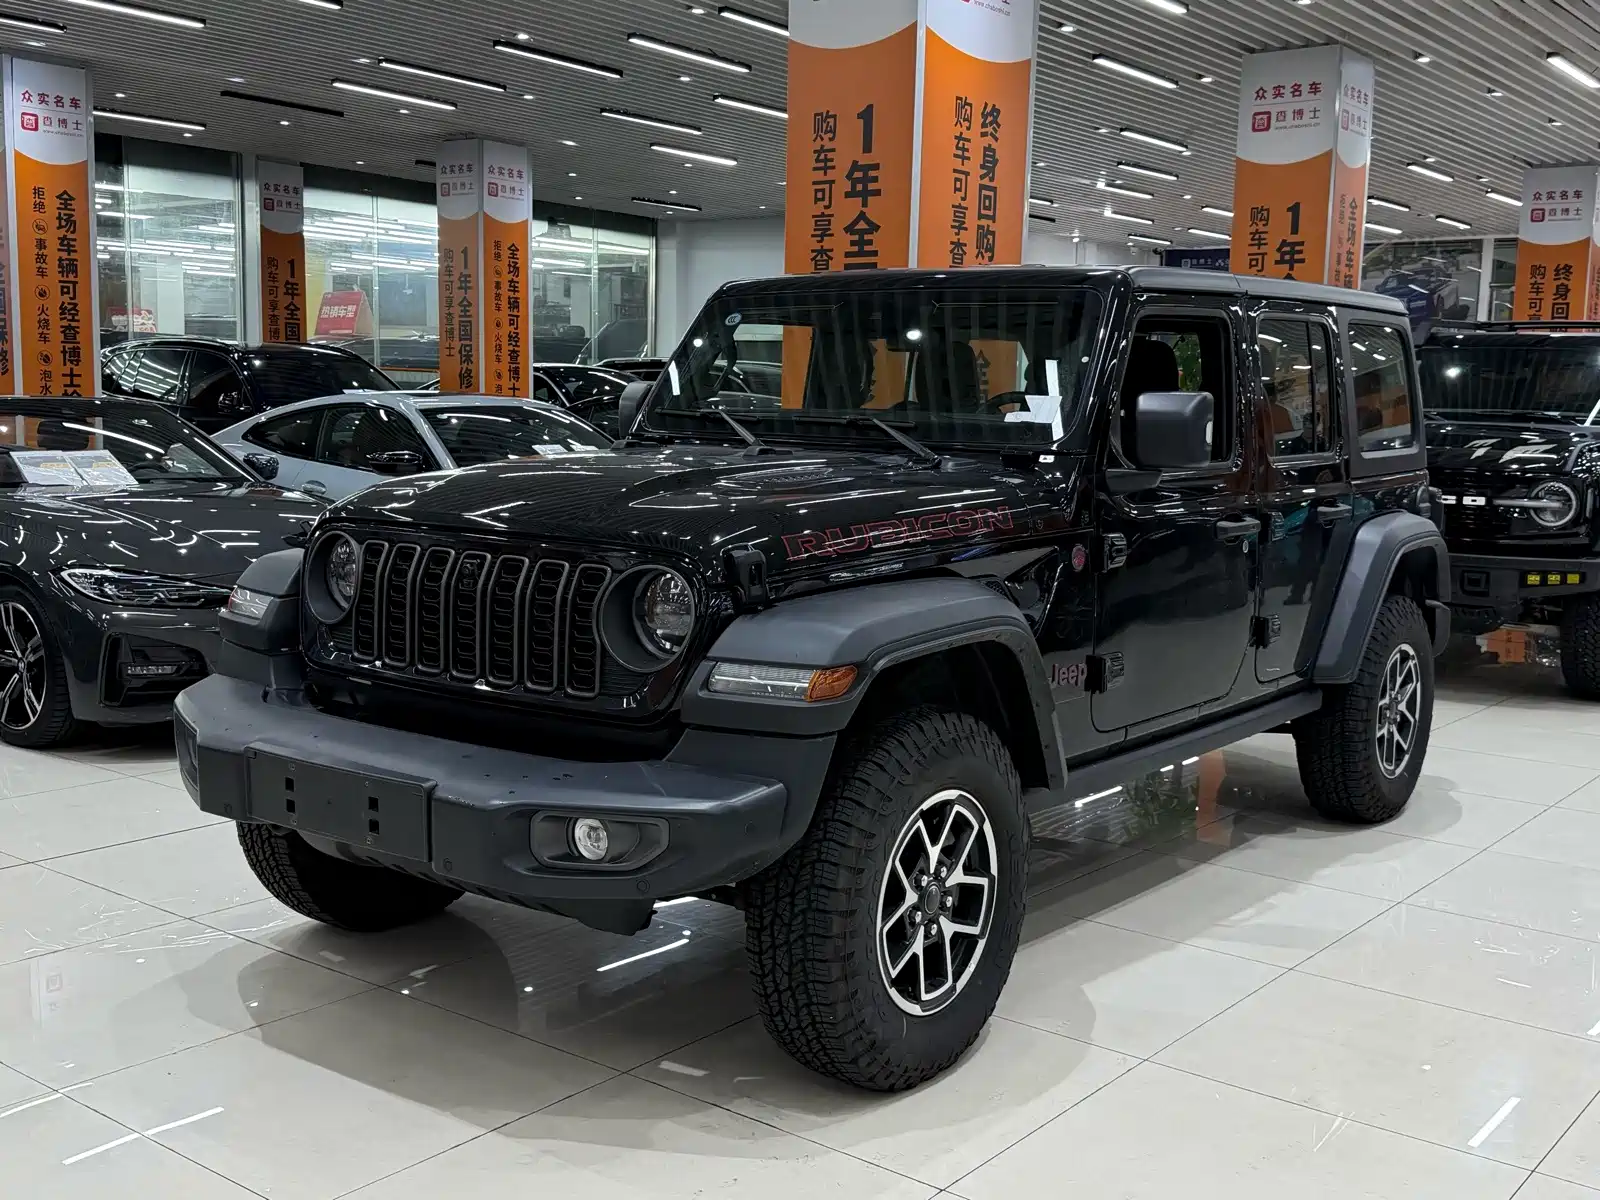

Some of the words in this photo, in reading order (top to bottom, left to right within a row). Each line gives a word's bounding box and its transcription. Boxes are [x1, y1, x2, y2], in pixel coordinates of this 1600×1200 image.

[21, 90, 82, 110] 众实名车
[1254, 81, 1322, 101] 众实名车
[263, 182, 301, 195] 众实名车
[440, 163, 474, 175] 众实名车
[488, 165, 524, 180] 众实名车
[843, 104, 882, 269] 1年全
[975, 101, 1002, 266] 终身回购
[32, 185, 47, 214] 拒绝
[1532, 190, 1583, 201] 众实名车
[34, 237, 48, 279] 事故车
[1247, 206, 1270, 276] 购车可
[266, 256, 281, 341] 购车可享查博
[283, 258, 301, 342] 1年全国
[443, 248, 455, 357] 购车可享查博士
[457, 246, 474, 390] 1年全国保修
[1551, 264, 1573, 330] 终身回
[37, 304, 51, 344] 火烧车
[507, 243, 521, 398] 全场车辆可经查博士
[40, 369, 53, 396] 泡水
[782, 505, 1014, 561] RUBICON
[1052, 662, 1087, 688] Jeep
